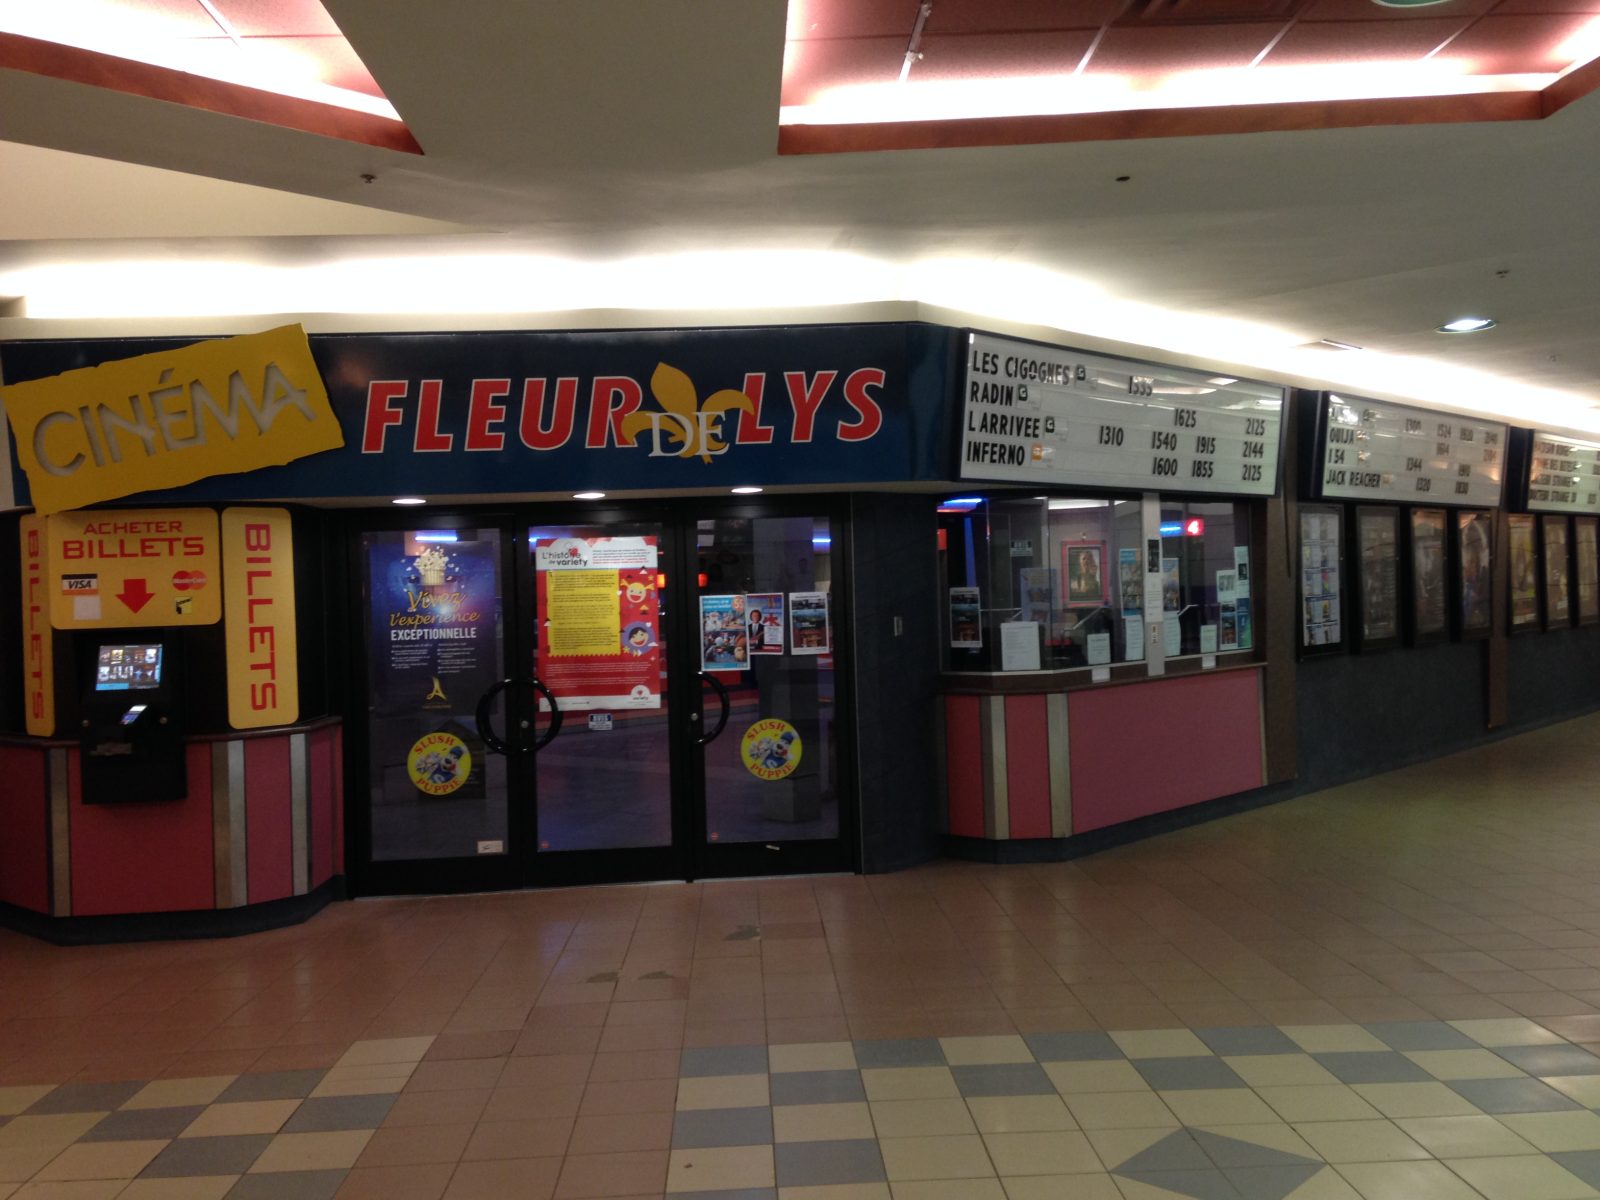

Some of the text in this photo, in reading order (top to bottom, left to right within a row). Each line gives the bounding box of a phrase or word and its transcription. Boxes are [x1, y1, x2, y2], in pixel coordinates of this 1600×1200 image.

[973, 350, 999, 375] LES
[1005, 356, 1070, 385] CIGOGNES
[970, 381, 1014, 406] RADIN
[33, 361, 317, 477] CINÉMA
[361, 367, 886, 457] FLEUR DE LYS
[968, 410, 976, 431] L
[979, 412, 1041, 438] ARRIVEE
[1174, 408, 1265, 436] 1625 2125
[1100, 425, 1264, 458] 1310 1540 1915 2144
[967, 441, 1025, 466] INFERNO
[1152, 457, 1178, 476] 1600
[1192, 460, 1213, 478] 1855
[1242, 464, 1262, 481] 2125
[1326, 469, 1346, 486] JACK
[83, 520, 183, 535] ACHETER
[63, 536, 205, 560] BILLETS
[68, 580, 92, 589] VISA
[28, 529, 44, 720] BILLETS
[245, 523, 278, 711] BILLETS
[390, 627, 477, 641] EXCEPTIONNELLE
[414, 735, 455, 754] SLUSH
[747, 721, 785, 741] SLUSH
